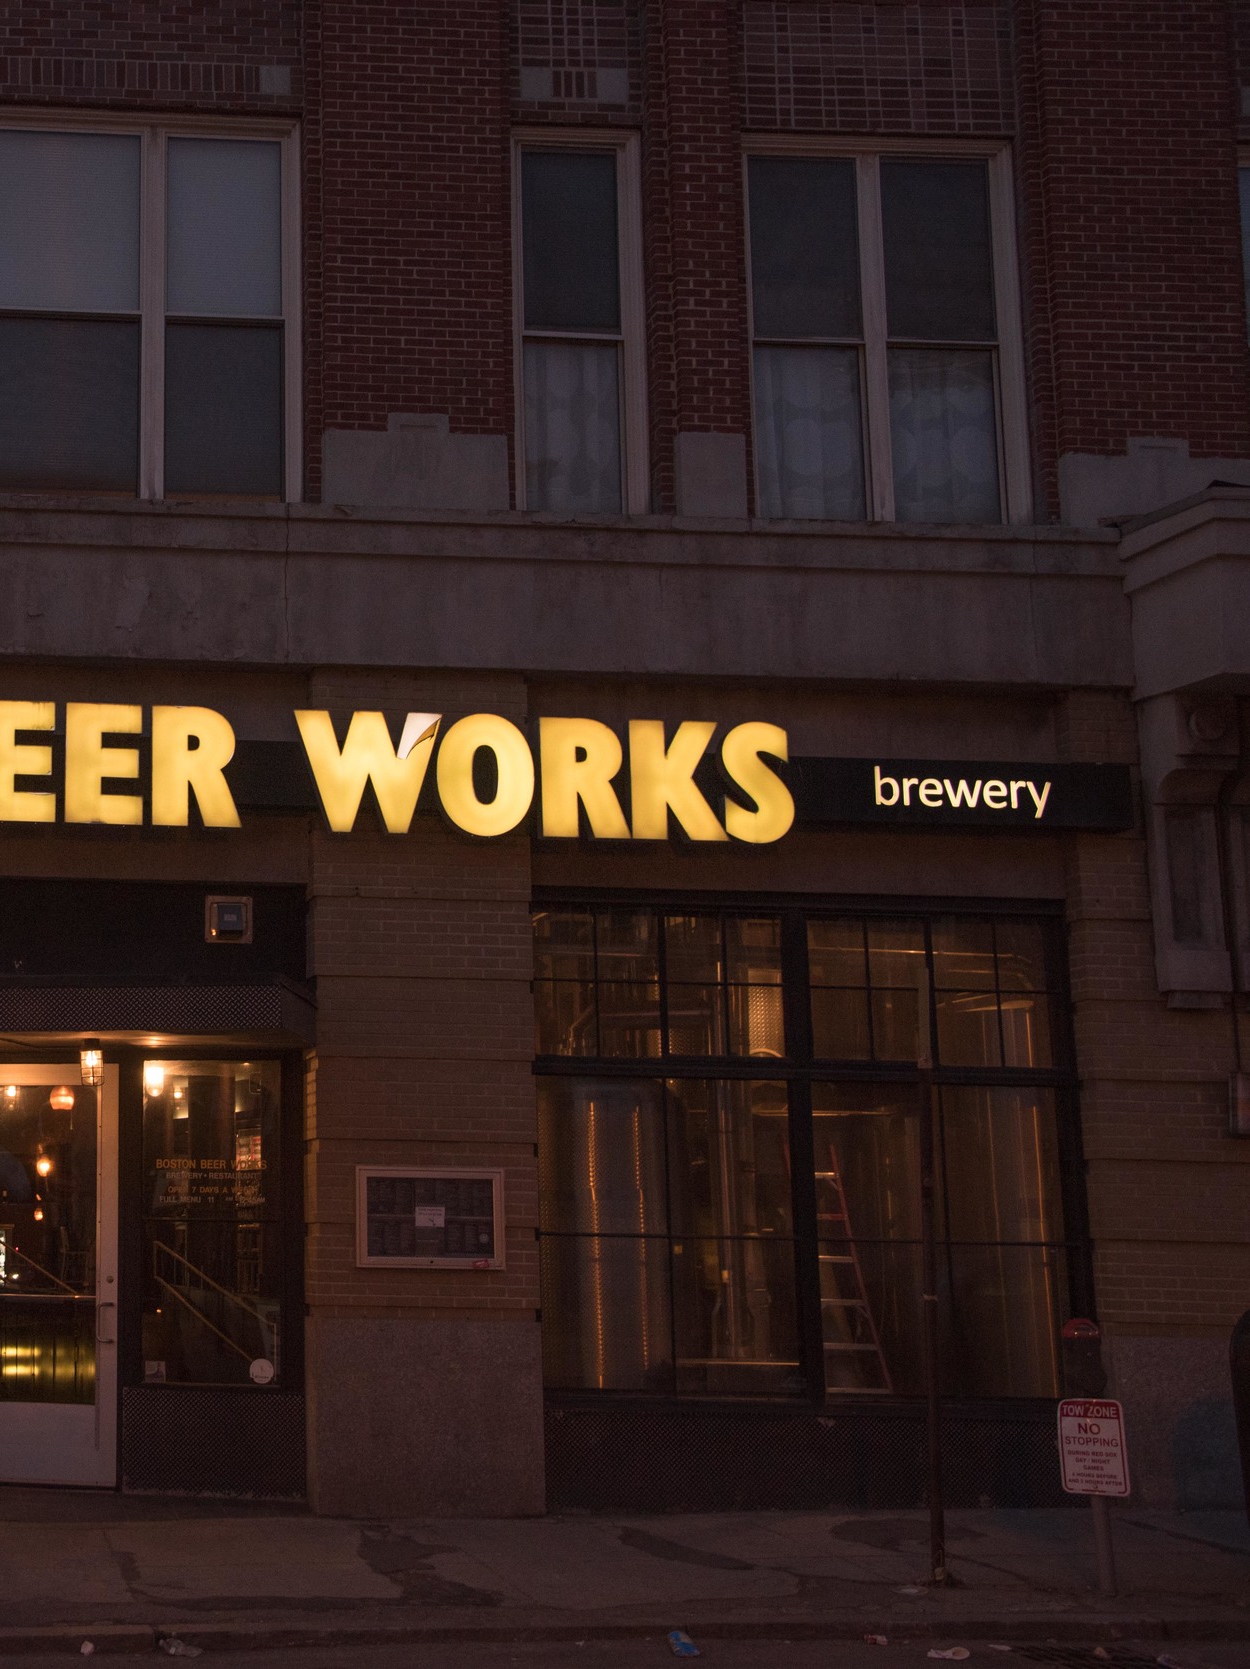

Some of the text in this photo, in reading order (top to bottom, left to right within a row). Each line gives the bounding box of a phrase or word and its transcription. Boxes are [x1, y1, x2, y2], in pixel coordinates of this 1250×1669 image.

[293, 709, 795, 844] WORKS
[874, 765, 1052, 819] brewery
[155, 1158, 196, 1169] BOSTON
[200, 1159, 227, 1170] BEER
[165, 1171, 203, 1180] BREWERY
[191, 1186, 196, 1194] 7
[199, 1186, 219, 1194] DAYS
[1062, 1405, 1118, 1418] TOW ZONE
[1077, 1423, 1100, 1435] NO
[1065, 1436, 1119, 1448] STOPPING
